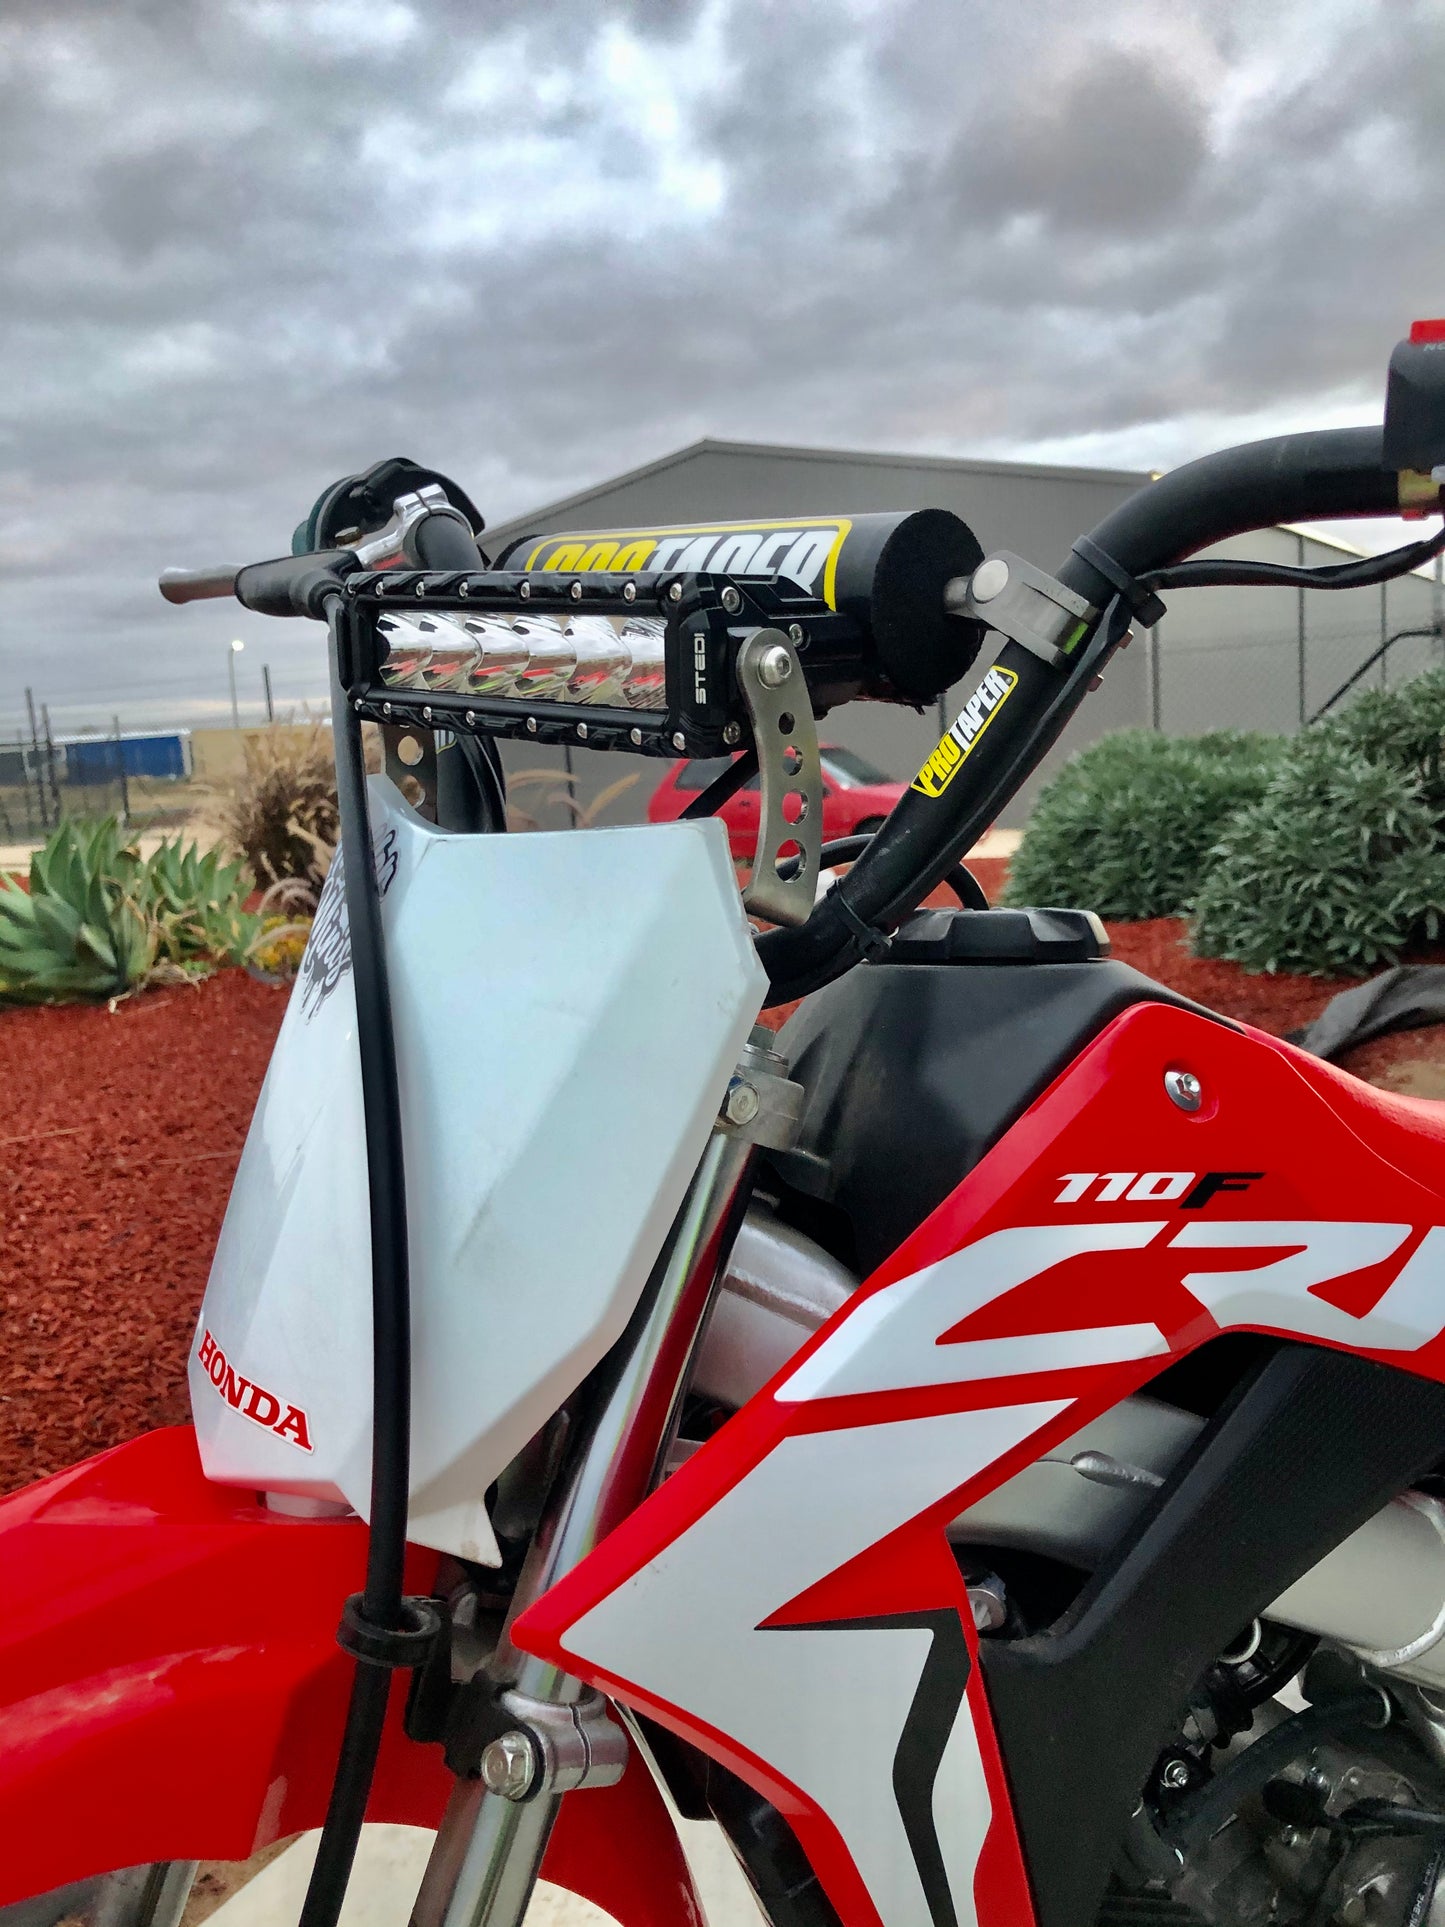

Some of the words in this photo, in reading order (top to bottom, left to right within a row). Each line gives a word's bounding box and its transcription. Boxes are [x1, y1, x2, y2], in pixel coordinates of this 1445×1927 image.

[694, 633, 706, 704] STEDI
[918, 669, 1010, 793] PROTAPER
[1054, 1172, 1266, 1209] 110F
[773, 1220, 1445, 1402] CR
[198, 1329, 312, 1450] HONDA
